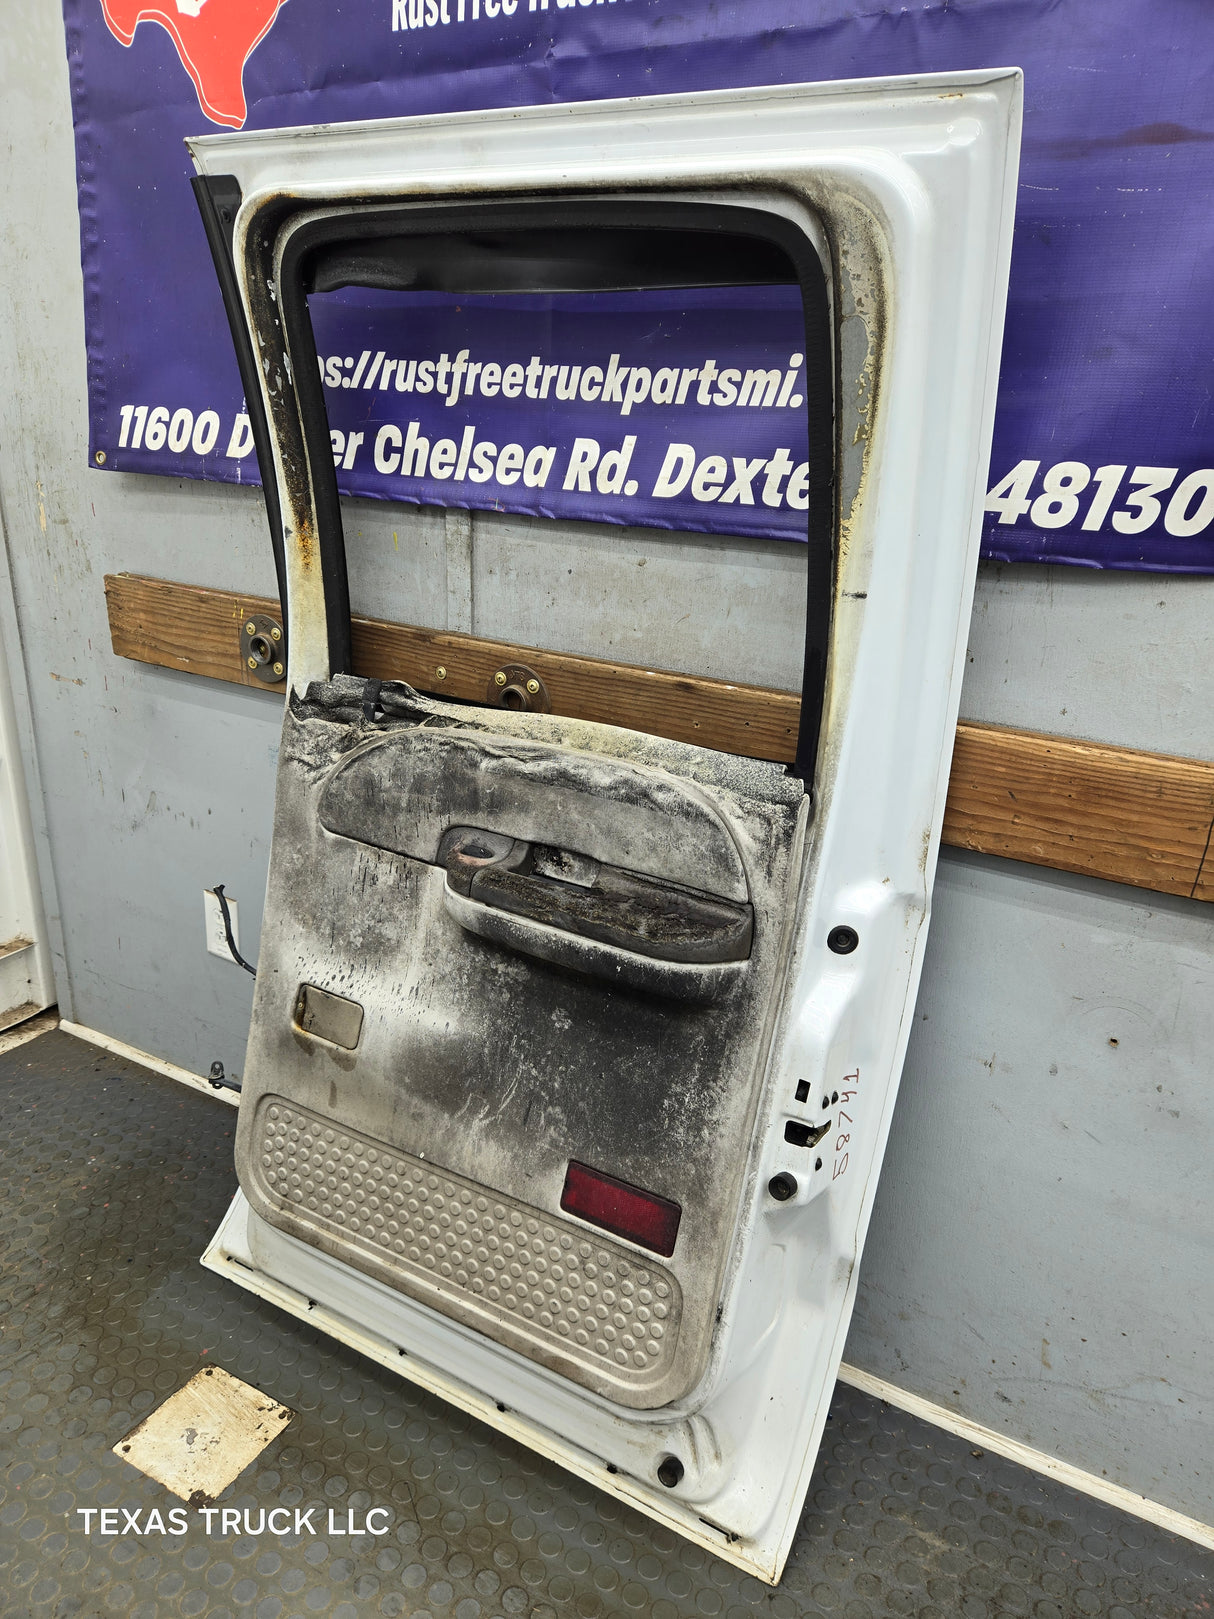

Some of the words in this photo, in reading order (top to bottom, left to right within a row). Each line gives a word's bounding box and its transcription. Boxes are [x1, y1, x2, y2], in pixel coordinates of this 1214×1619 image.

[118, 404, 221, 456] 11600
[373, 421, 557, 487] Chelsea
[562, 435, 639, 496] Rd.
[651, 443, 810, 510] Dexte
[984, 459, 1214, 538] 48130
[832, 1067, 860, 1181] 58741
